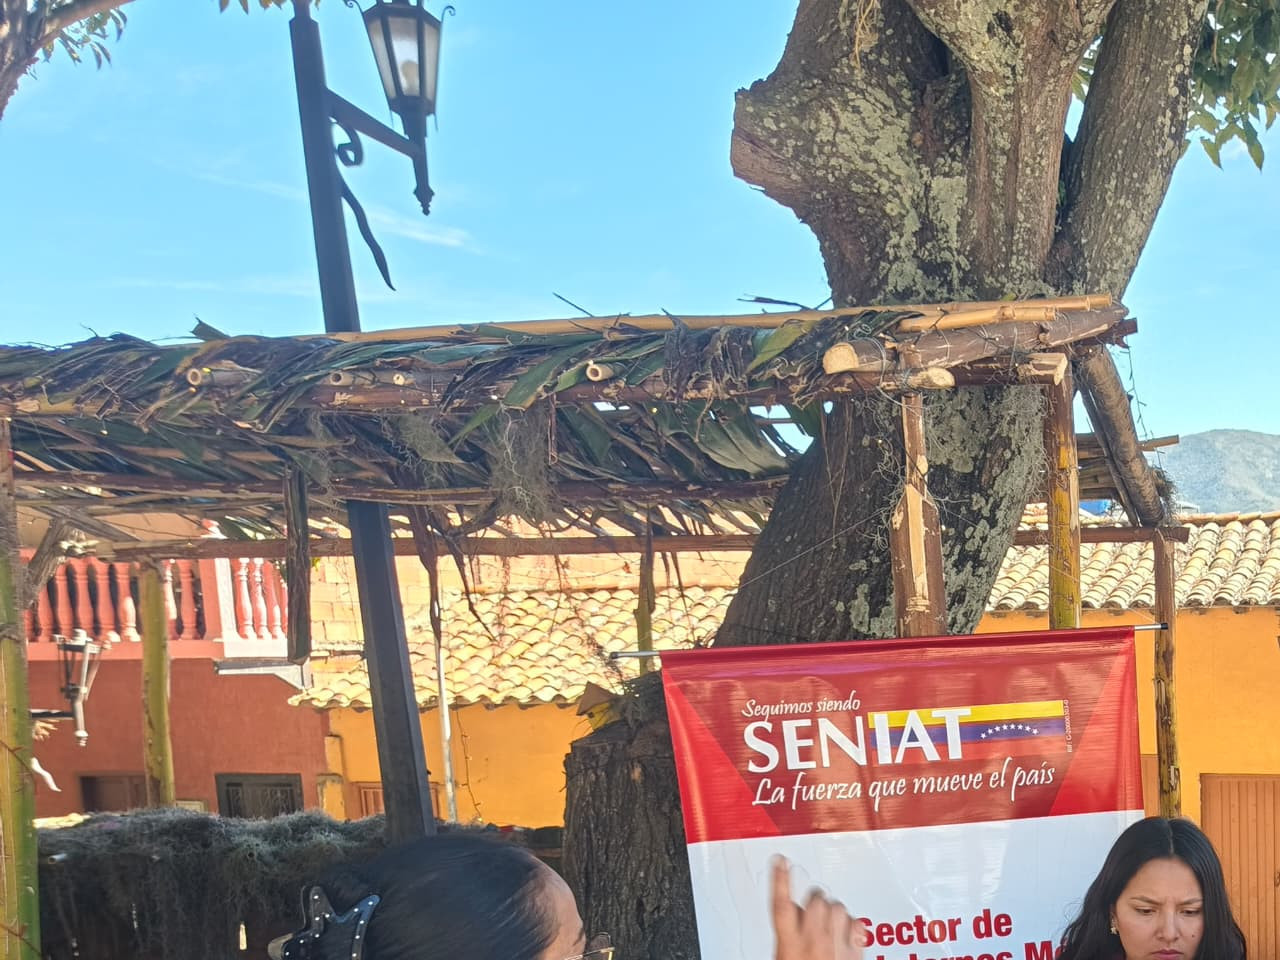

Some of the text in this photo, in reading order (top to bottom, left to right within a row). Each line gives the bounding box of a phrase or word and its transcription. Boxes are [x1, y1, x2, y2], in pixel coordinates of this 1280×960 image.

[815, 690, 861, 713] siendo
[743, 708, 972, 773] SENIAT
[751, 757, 1056, 813] La fuerza que mueve el país
[855, 908, 1012, 948] Sector de
